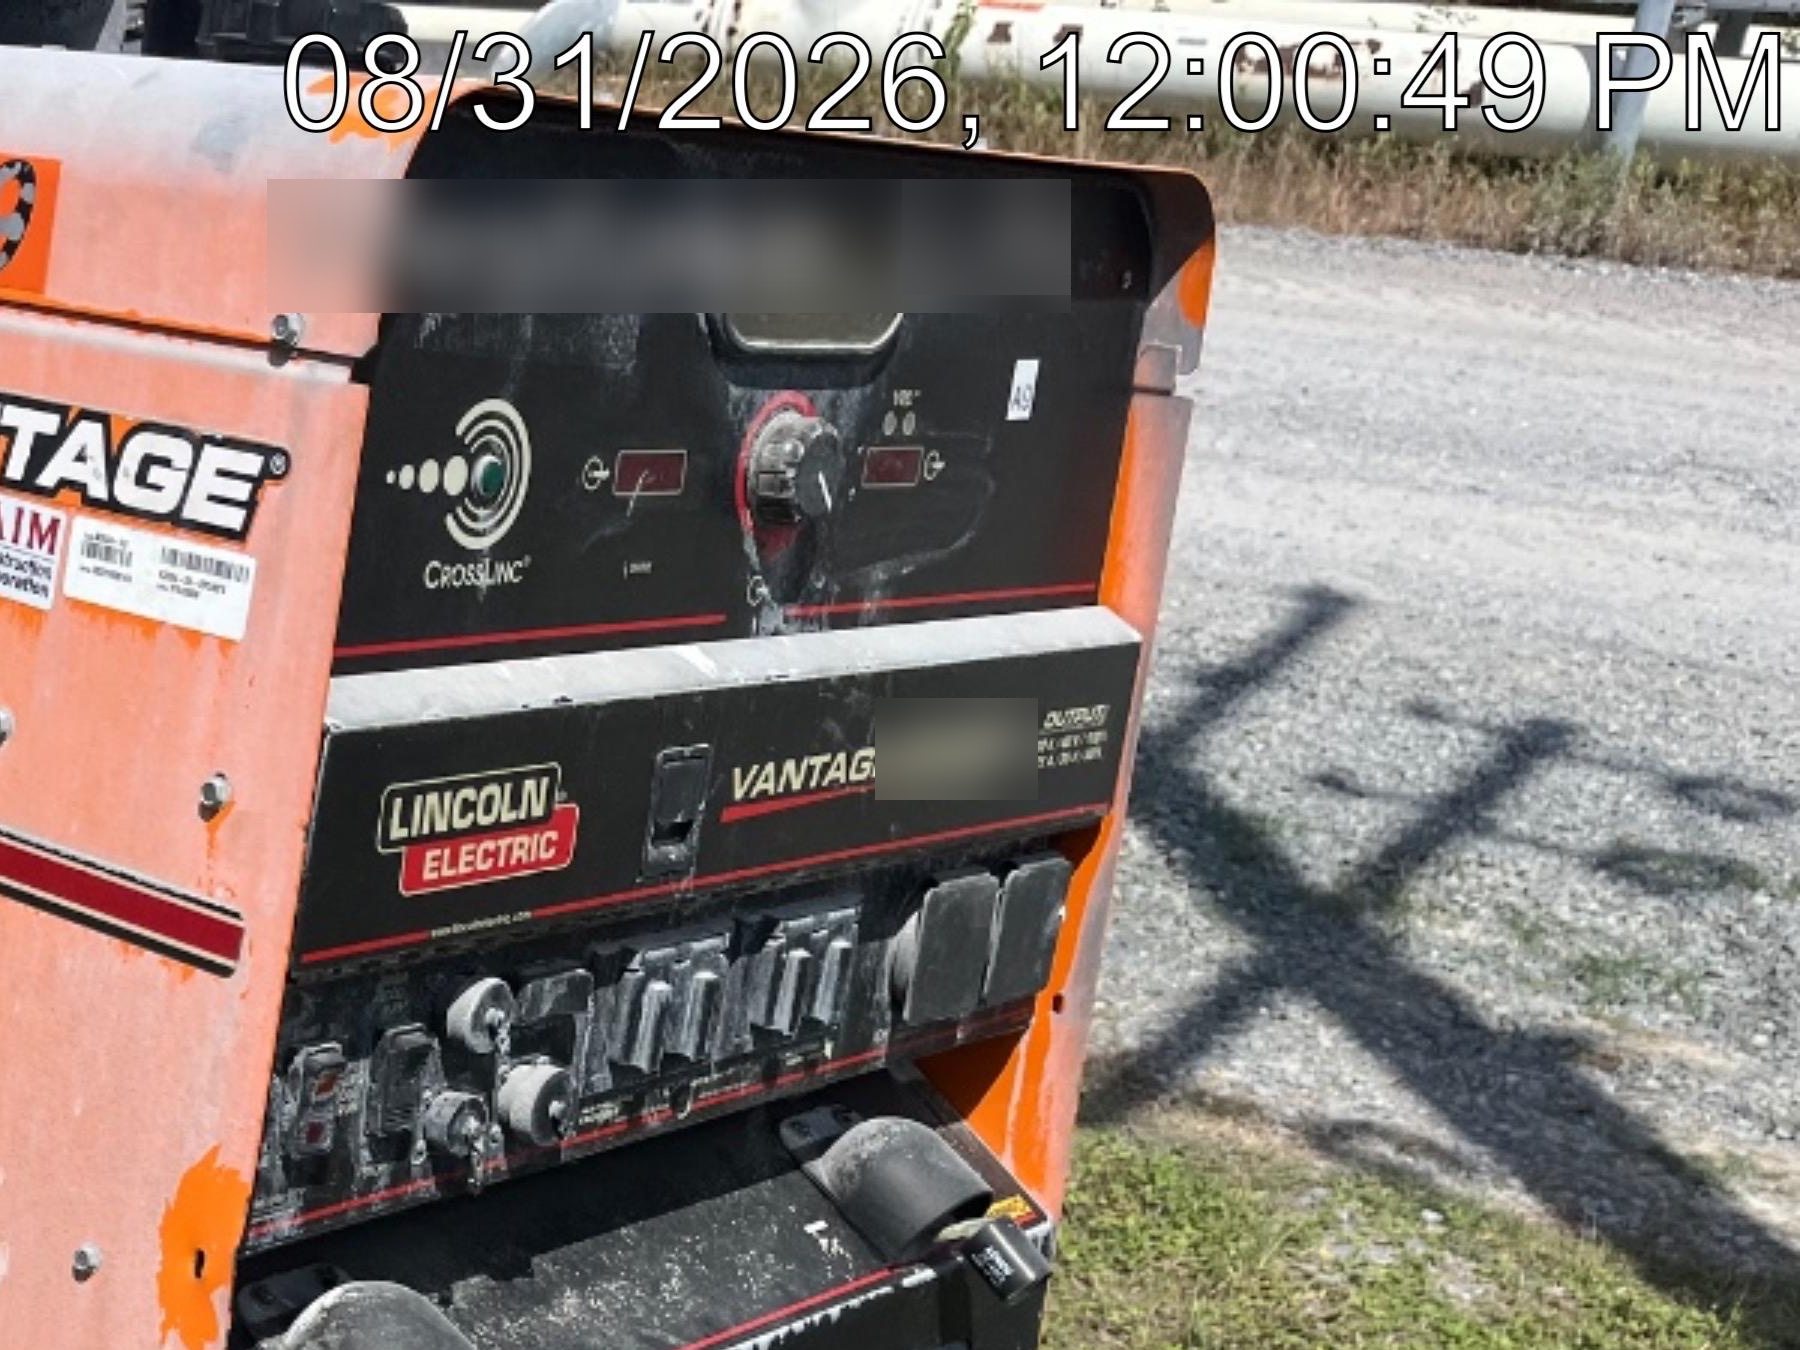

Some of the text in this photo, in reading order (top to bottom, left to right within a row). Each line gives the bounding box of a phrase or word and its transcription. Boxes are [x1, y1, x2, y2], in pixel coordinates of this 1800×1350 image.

[731, 747, 876, 801] VANTAG
[388, 775, 551, 841] LINCOLN
[421, 829, 560, 882] ELECTRIC
